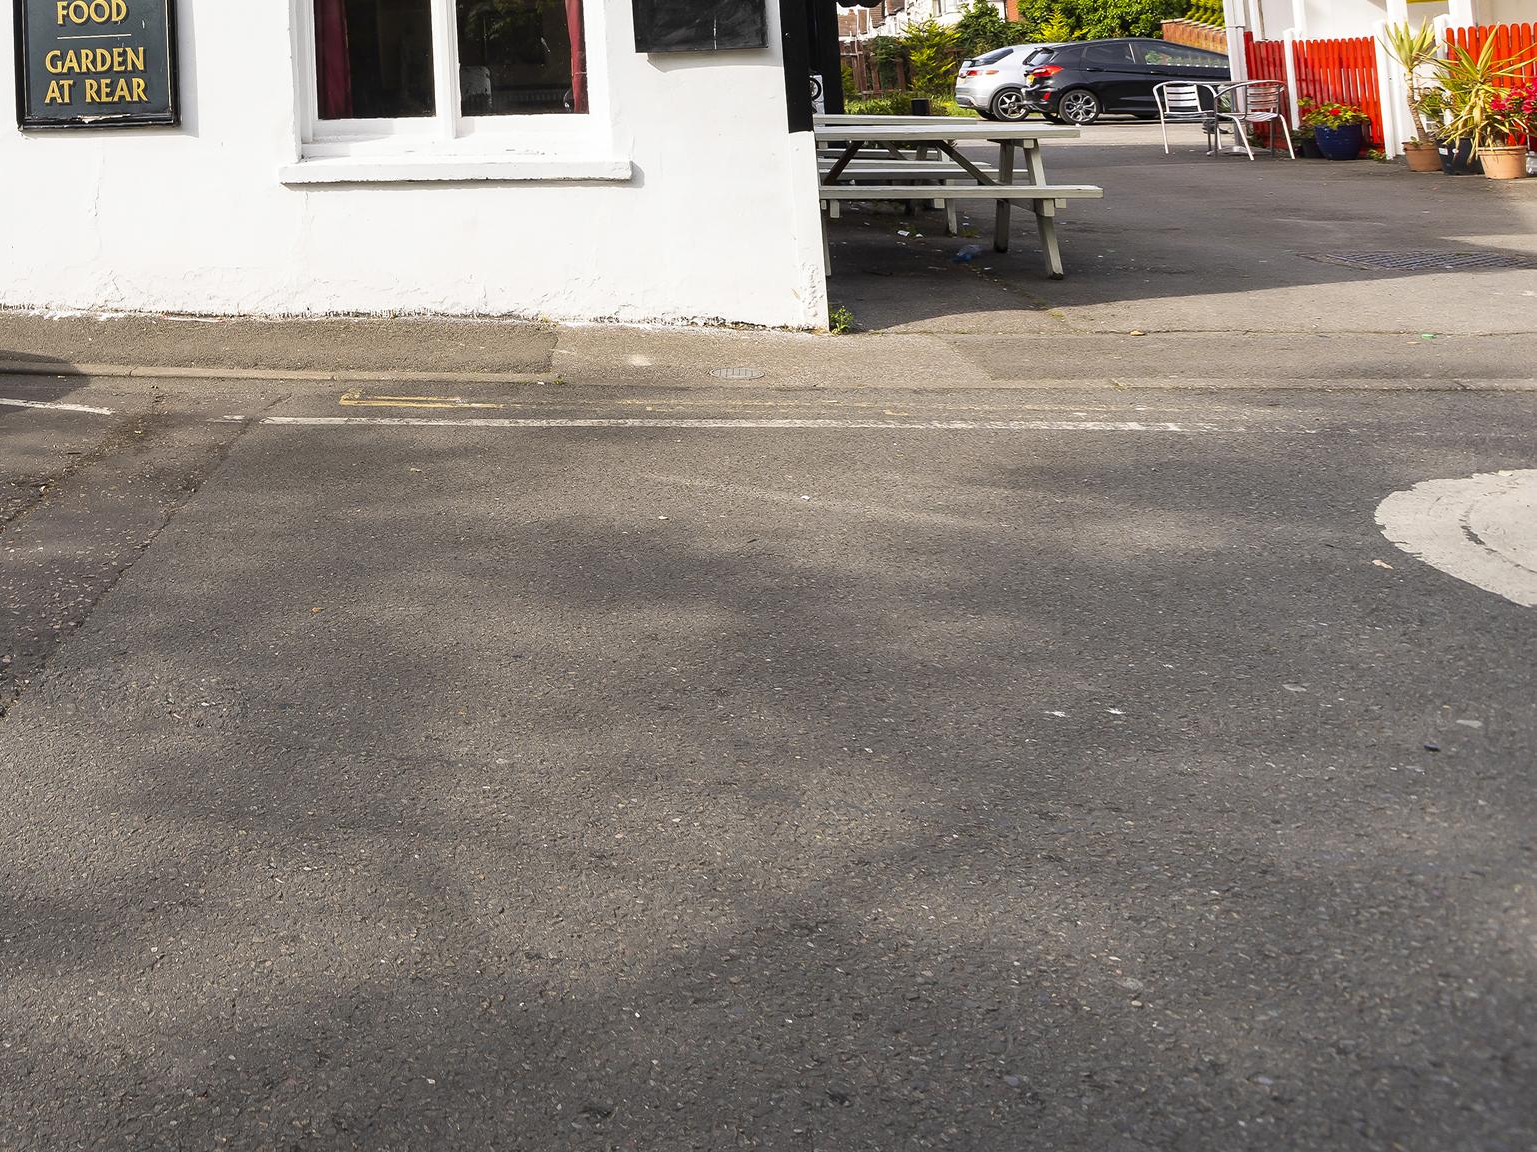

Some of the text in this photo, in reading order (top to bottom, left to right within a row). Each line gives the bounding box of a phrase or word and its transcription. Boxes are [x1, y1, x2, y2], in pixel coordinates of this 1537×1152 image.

[45, 46, 144, 74] GARDEN
[44, 77, 148, 104] AT REAR
